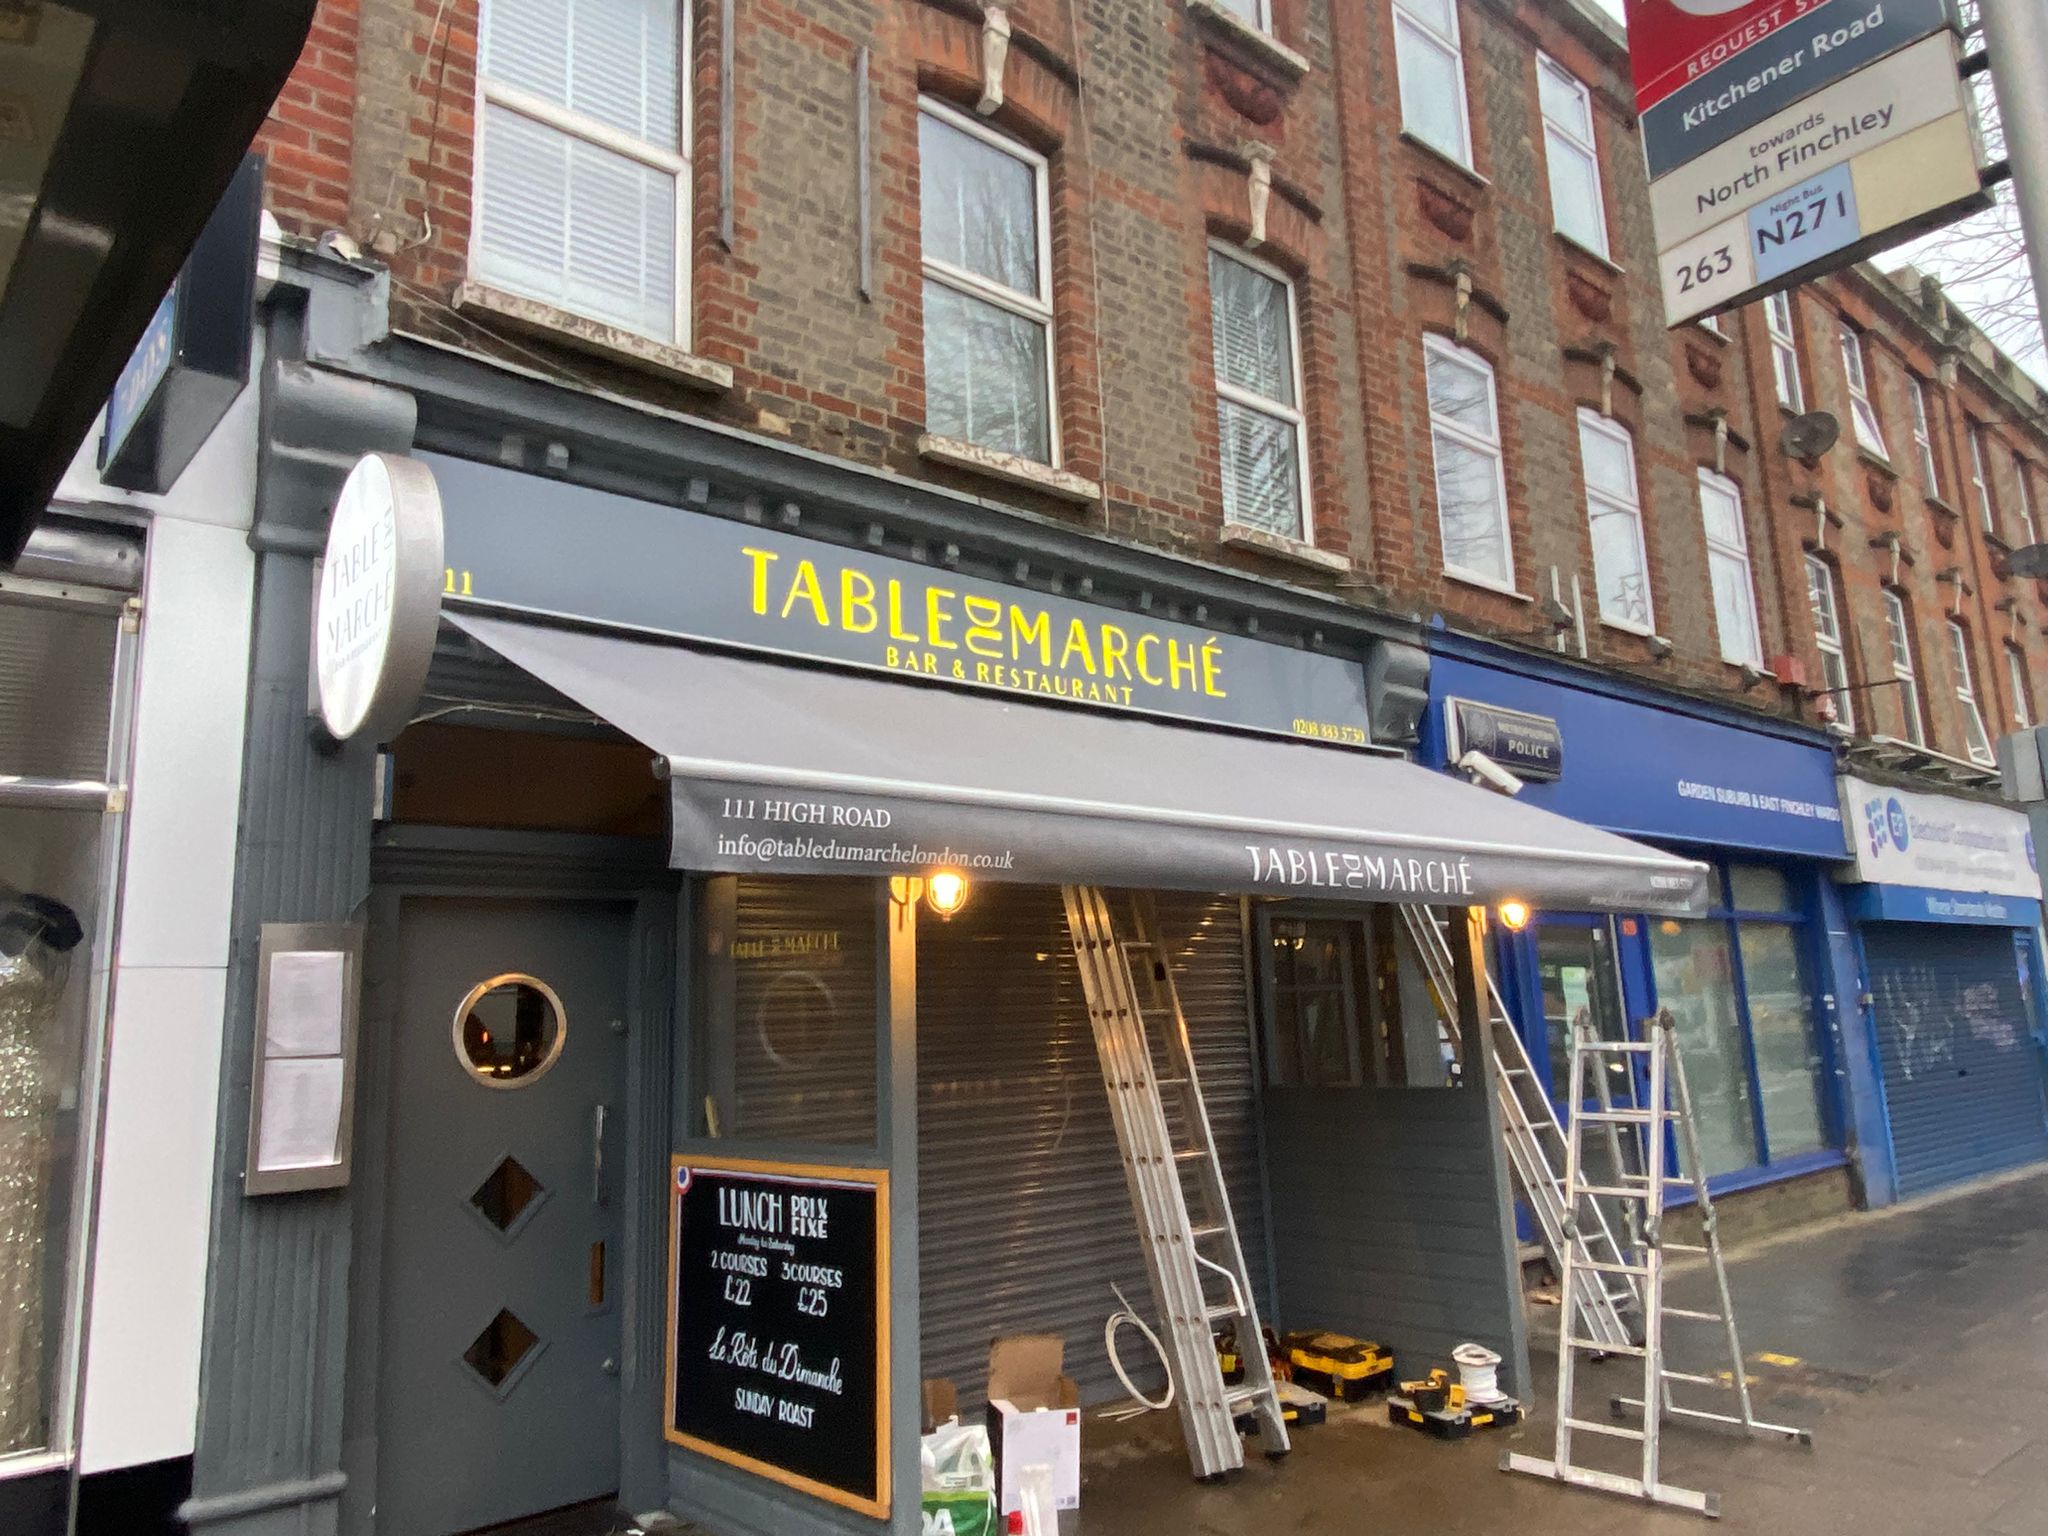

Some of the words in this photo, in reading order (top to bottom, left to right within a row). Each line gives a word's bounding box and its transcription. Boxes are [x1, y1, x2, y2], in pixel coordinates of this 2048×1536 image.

[1687, 10, 1781, 77] REQUEST
[1682, 48, 1804, 131] Kitchener
[1812, 5, 1884, 59] Road
[1749, 111, 1825, 158] towards
[1697, 163, 1770, 213] North
[1778, 103, 1894, 172] Finchley
[1802, 185, 1824, 199] Bus
[1757, 190, 1847, 254] N271
[1677, 245, 1733, 294] 263
[331, 522, 380, 598] TABLE
[742, 546, 957, 650] TABLE
[964, 594, 1004, 658] DU
[1010, 603, 1227, 699] MARCHÉ
[886, 645, 938, 675] BAR
[952, 660, 966, 680] &
[976, 662, 1134, 706] RESTAURANT
[1508, 739, 1549, 759] POLICE
[721, 798, 755, 819] 111
[763, 800, 826, 825] HIGH
[831, 805, 892, 829] ROAD
[1677, 780, 1716, 801] GARDEN
[1716, 787, 1751, 807] SUBURB
[1759, 795, 1780, 811] EAST
[717, 834, 1016, 870] info@tabledumarchelondon.co.uk
[1245, 845, 1340, 887] TABLE
[1344, 854, 1366, 889] DU
[1365, 855, 1475, 896] MARCHÉ
[719, 1187, 783, 1233] LUNCH
[791, 1195, 828, 1220] PRIX
[791, 1216, 828, 1239] FIXE
[711, 1250, 718, 1268] 2
[720, 1251, 768, 1277] COURSES
[724, 1274, 752, 1306] £22
[797, 1286, 828, 1317] £25
[762, 1341, 777, 1374] du
[778, 1343, 843, 1395] Dimanche
[735, 1387, 775, 1418] SUNDAY
[779, 1400, 815, 1429] ROAST
